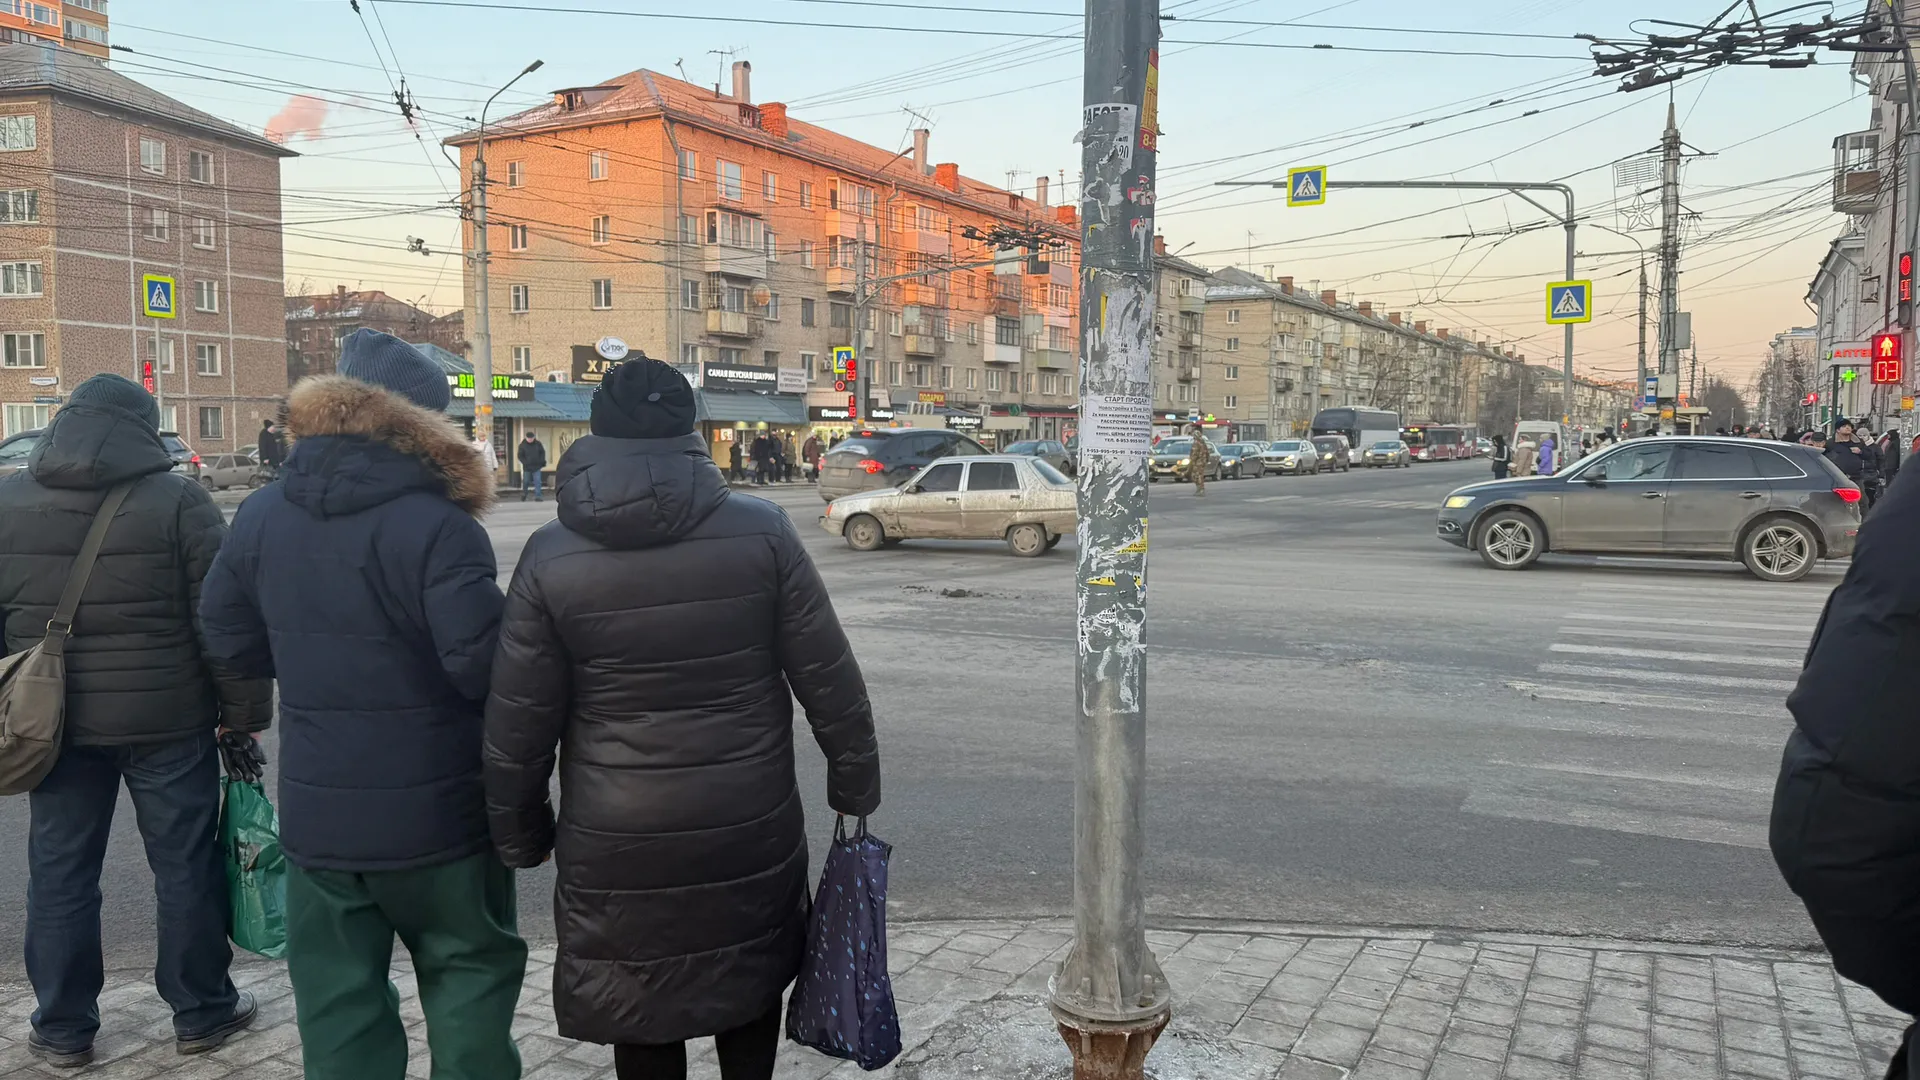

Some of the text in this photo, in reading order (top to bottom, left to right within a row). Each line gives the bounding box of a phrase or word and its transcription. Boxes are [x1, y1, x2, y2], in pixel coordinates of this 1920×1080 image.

[708, 369, 728, 378] САМАЯ
[728, 370, 753, 380] ВКУСНАЯ
[753, 372, 776, 381] ШАУРМА
[1876, 361, 1899, 382] 03
[491, 375, 510, 389] ITY
[491, 389, 518, 399] ФРУКТЫ
